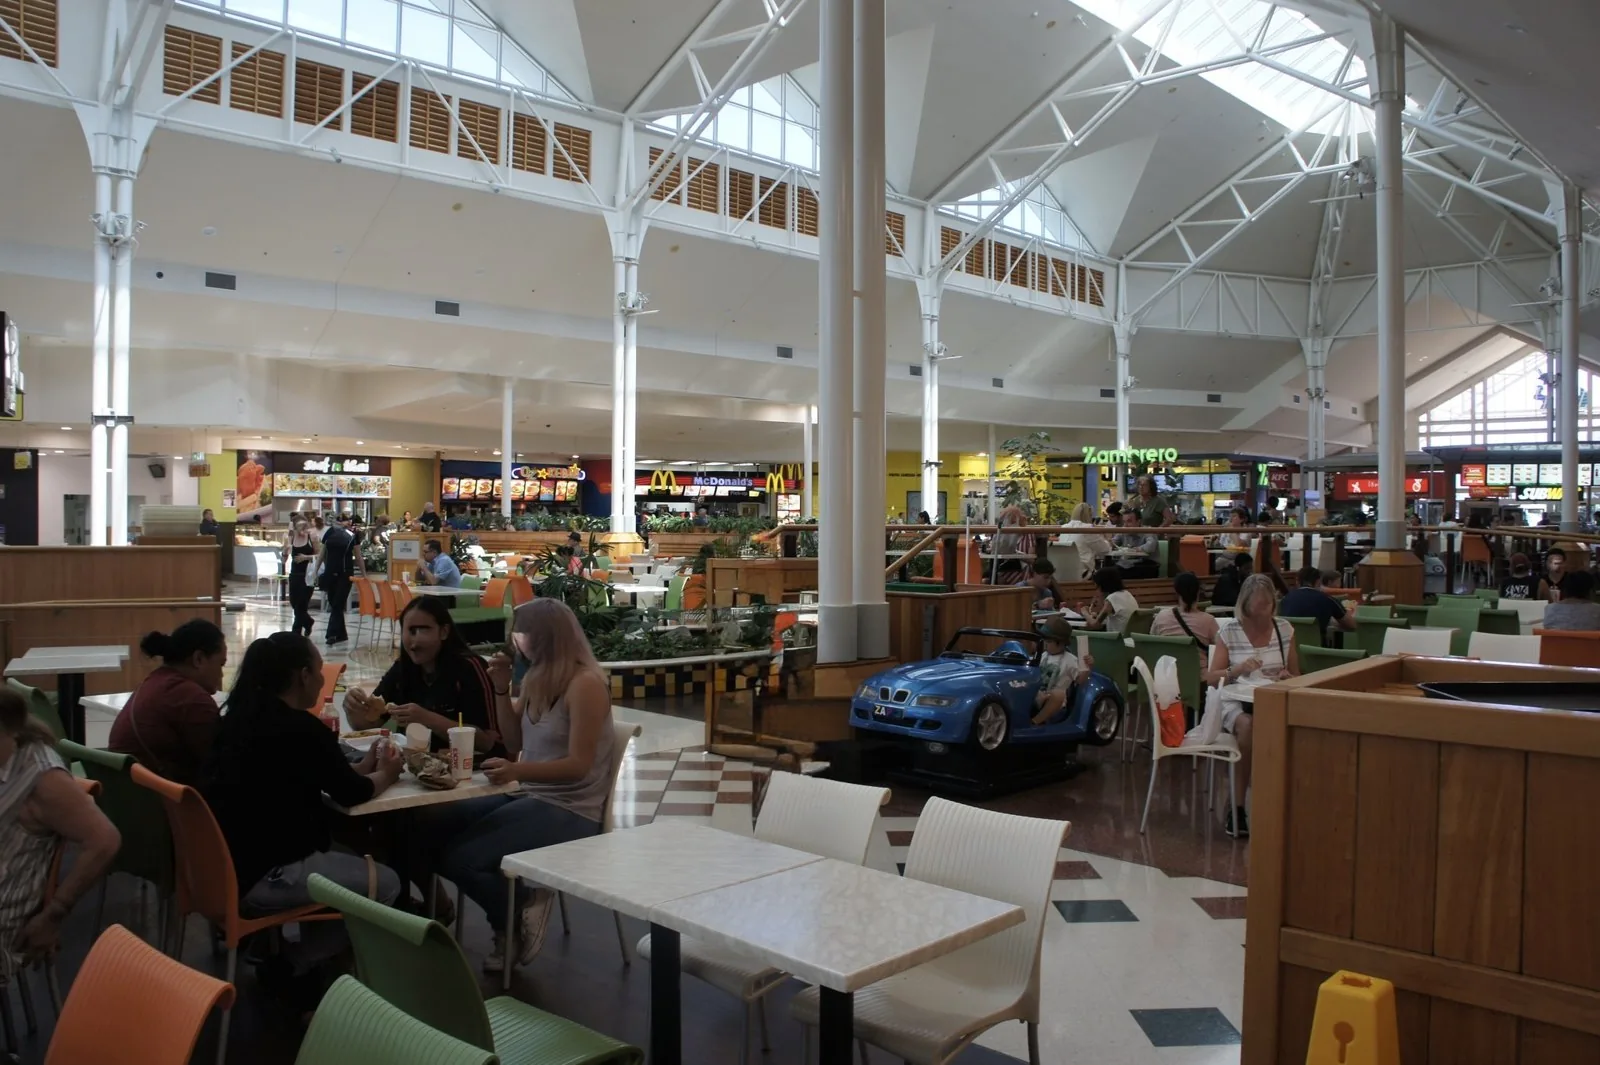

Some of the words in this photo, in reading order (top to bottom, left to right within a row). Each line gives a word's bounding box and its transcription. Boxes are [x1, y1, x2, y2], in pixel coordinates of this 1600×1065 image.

[1082, 445, 1178, 464] Zambrero
[693, 477, 753, 486] McDonald's
[1271, 473, 1289, 482] KFC
